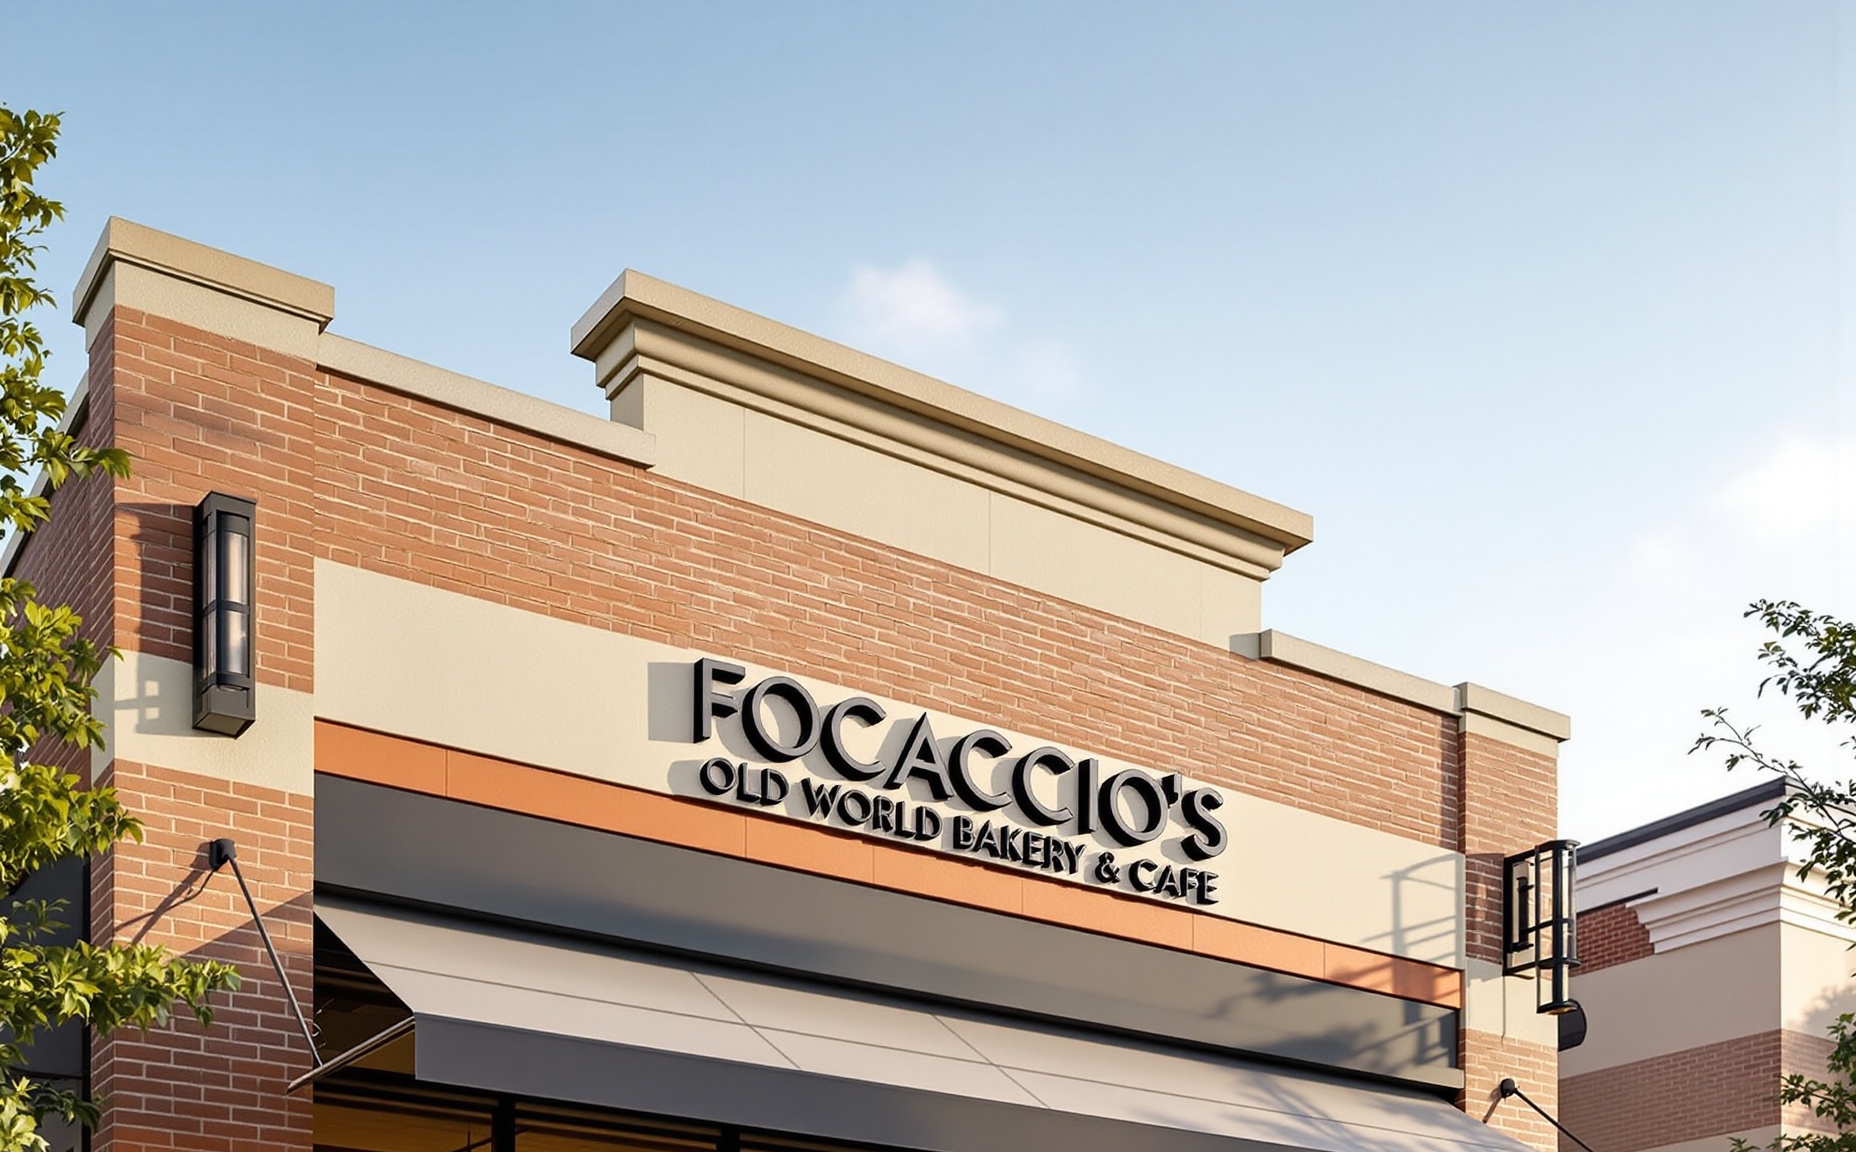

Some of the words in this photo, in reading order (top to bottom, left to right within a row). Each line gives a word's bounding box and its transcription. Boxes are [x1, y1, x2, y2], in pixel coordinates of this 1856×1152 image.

[694, 657, 1228, 861] FOCACCIO'S
[700, 757, 789, 806] OLD
[801, 777, 943, 840] WORLD
[953, 815, 1086, 874] BAKERY
[1095, 851, 1121, 883] &
[1129, 859, 1219, 904] CAFE
